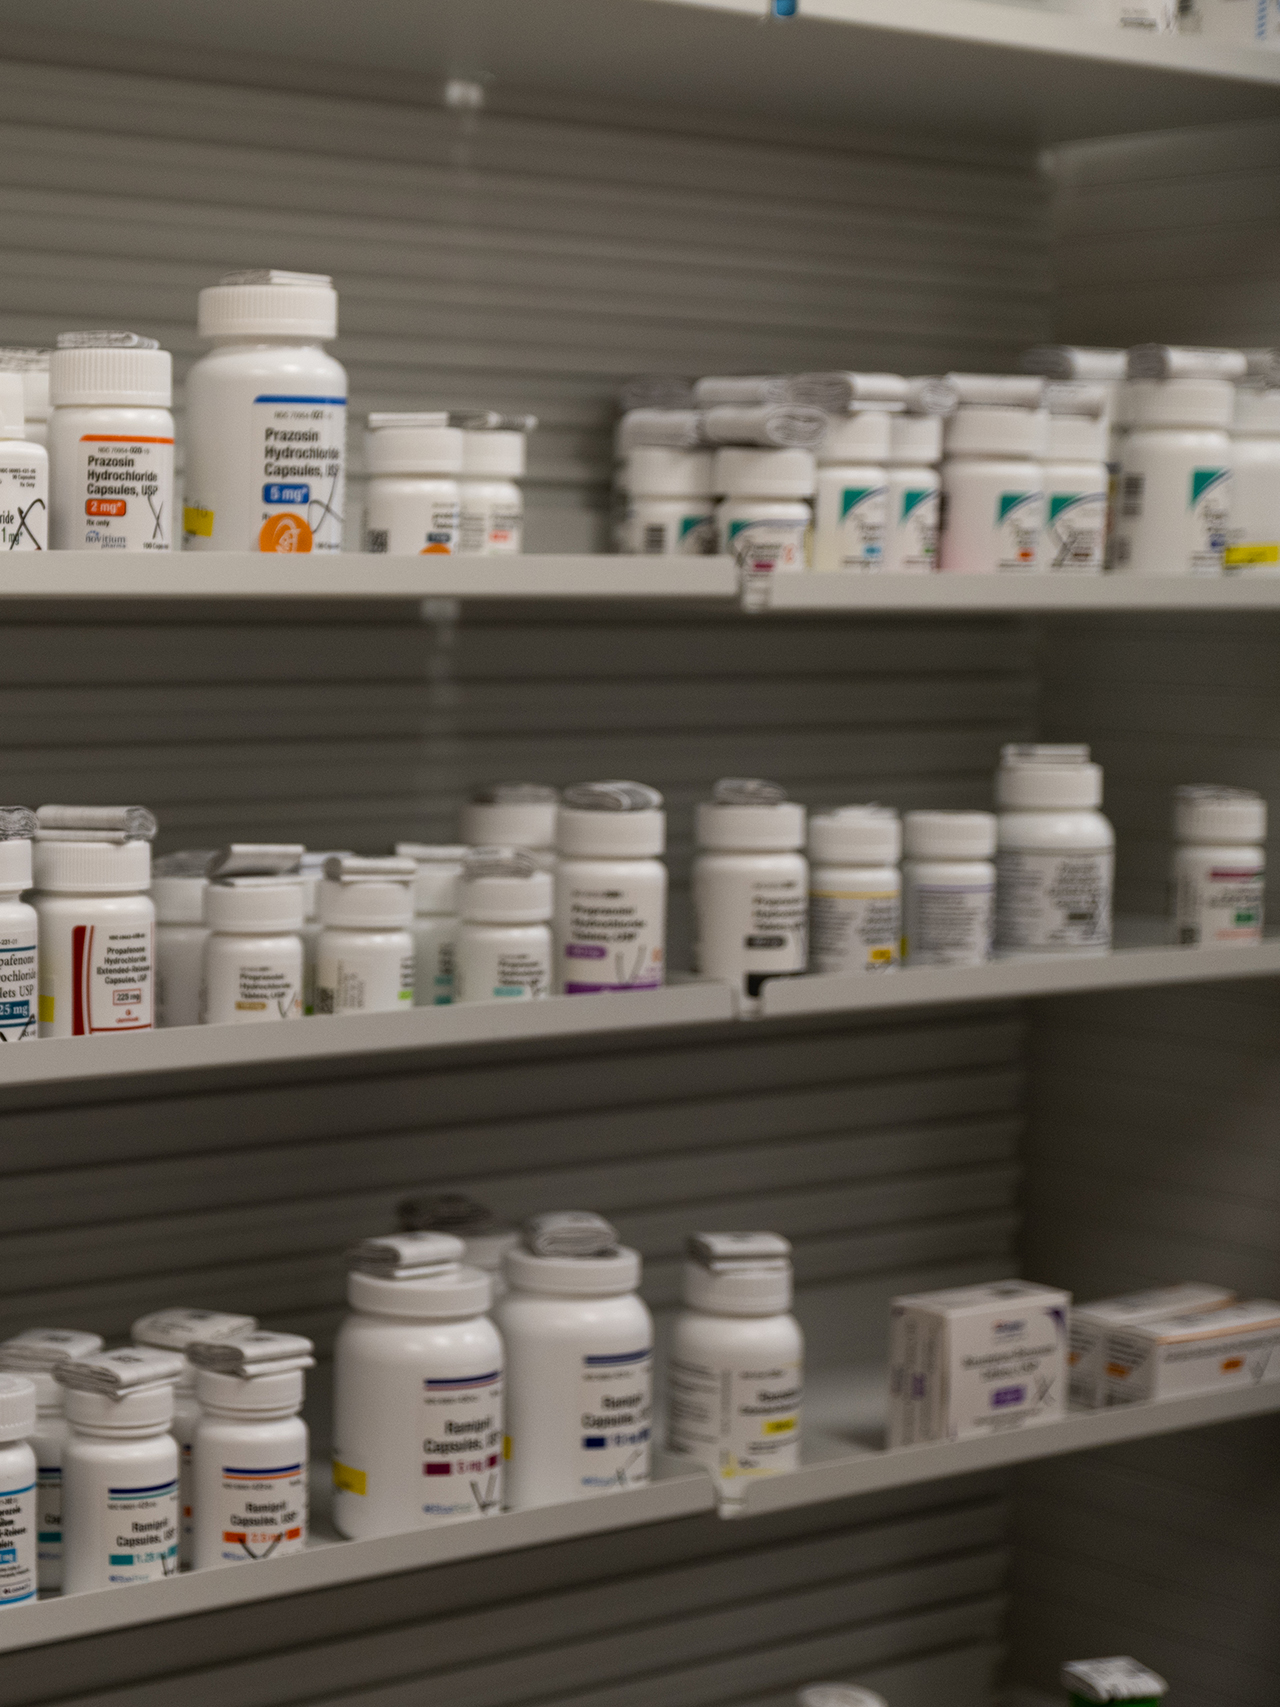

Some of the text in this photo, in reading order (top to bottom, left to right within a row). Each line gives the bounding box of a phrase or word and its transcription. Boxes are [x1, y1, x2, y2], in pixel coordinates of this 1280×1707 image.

[265, 427, 319, 442] Prazosin
[88, 455, 135, 467] Prazosin
[87, 469, 158, 483] Hydrochloride
[264, 462, 323, 479] Capsules,
[87, 483, 158, 497] Capsules, USP
[91, 501, 98, 512] 2
[96, 519, 110, 527] only
[1, 527, 6, 542] 1
[85, 534, 126, 543] novitium
[19, 984, 34, 997] USP
[117, 993, 130, 1001] 225
[13, 1005, 28, 1017] mg
[2, 1554, 14, 1564] mg
